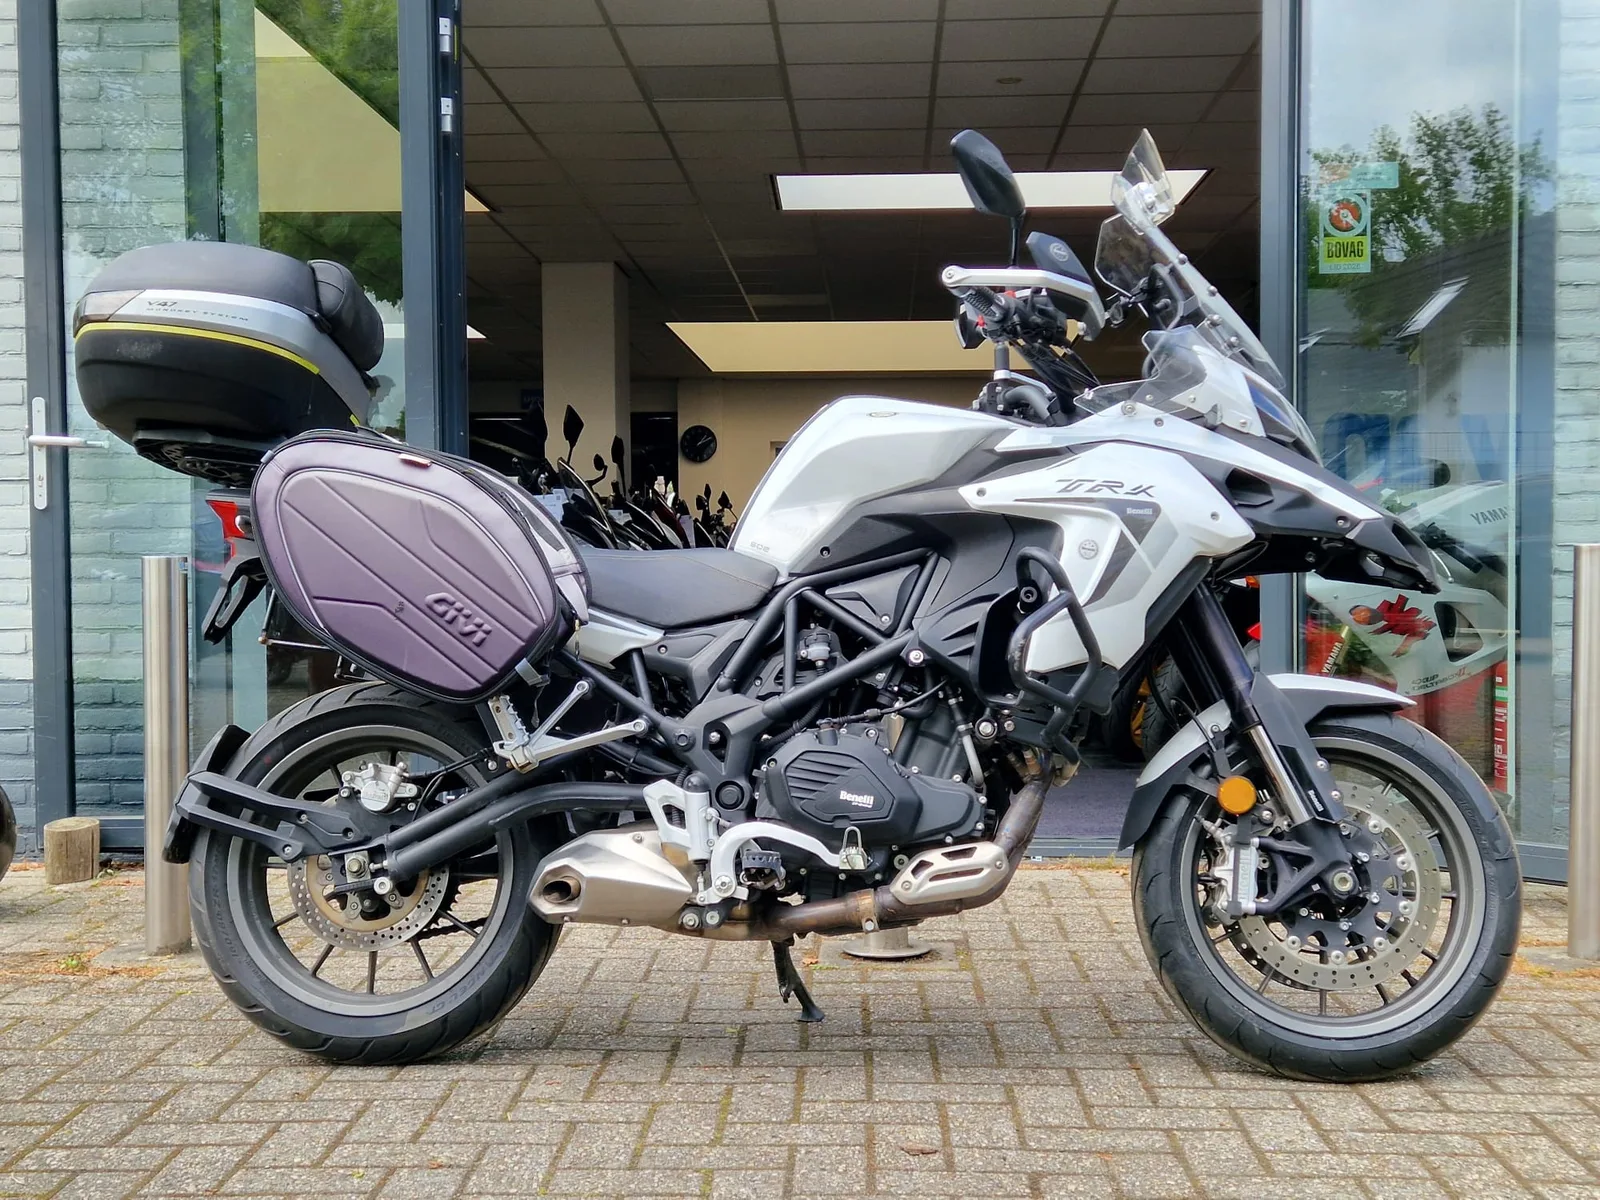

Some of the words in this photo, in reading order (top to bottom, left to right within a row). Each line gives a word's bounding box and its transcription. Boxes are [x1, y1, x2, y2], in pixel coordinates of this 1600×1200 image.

[1327, 241, 1364, 258] BOVAG
[1056, 479, 1155, 498] TRK
[1321, 641, 1344, 673] YAMAHA
[840, 790, 874, 805] Benelli
